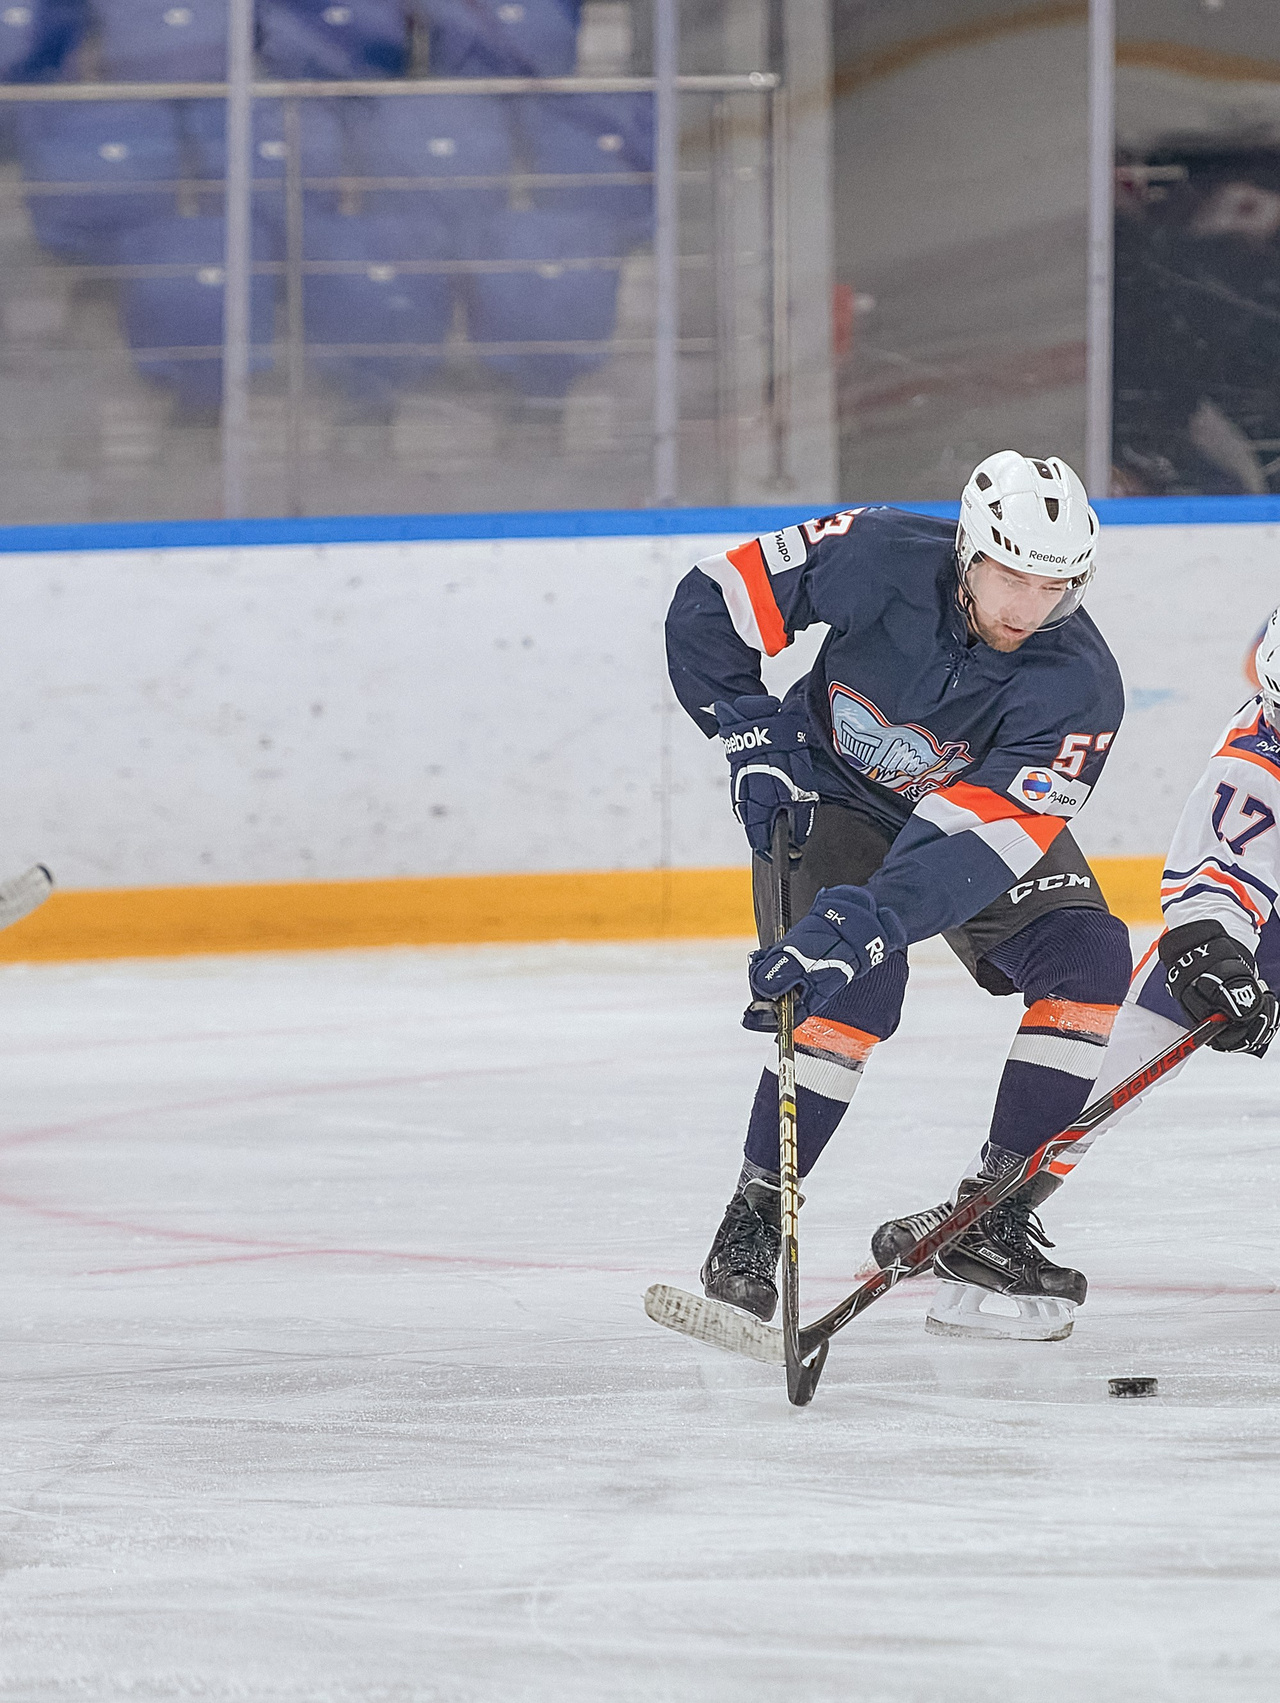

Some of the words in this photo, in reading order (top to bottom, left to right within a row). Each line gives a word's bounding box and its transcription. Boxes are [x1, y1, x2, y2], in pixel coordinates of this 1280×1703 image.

[1029, 550, 1068, 564] Reebok
[1212, 781, 1276, 857] 17
[1007, 873, 1091, 904] CCM
[864, 935, 885, 969] Re
[1167, 943, 1210, 983] GUY
[764, 955, 790, 982] Reebok
[871, 1283, 887, 1298] LITE
